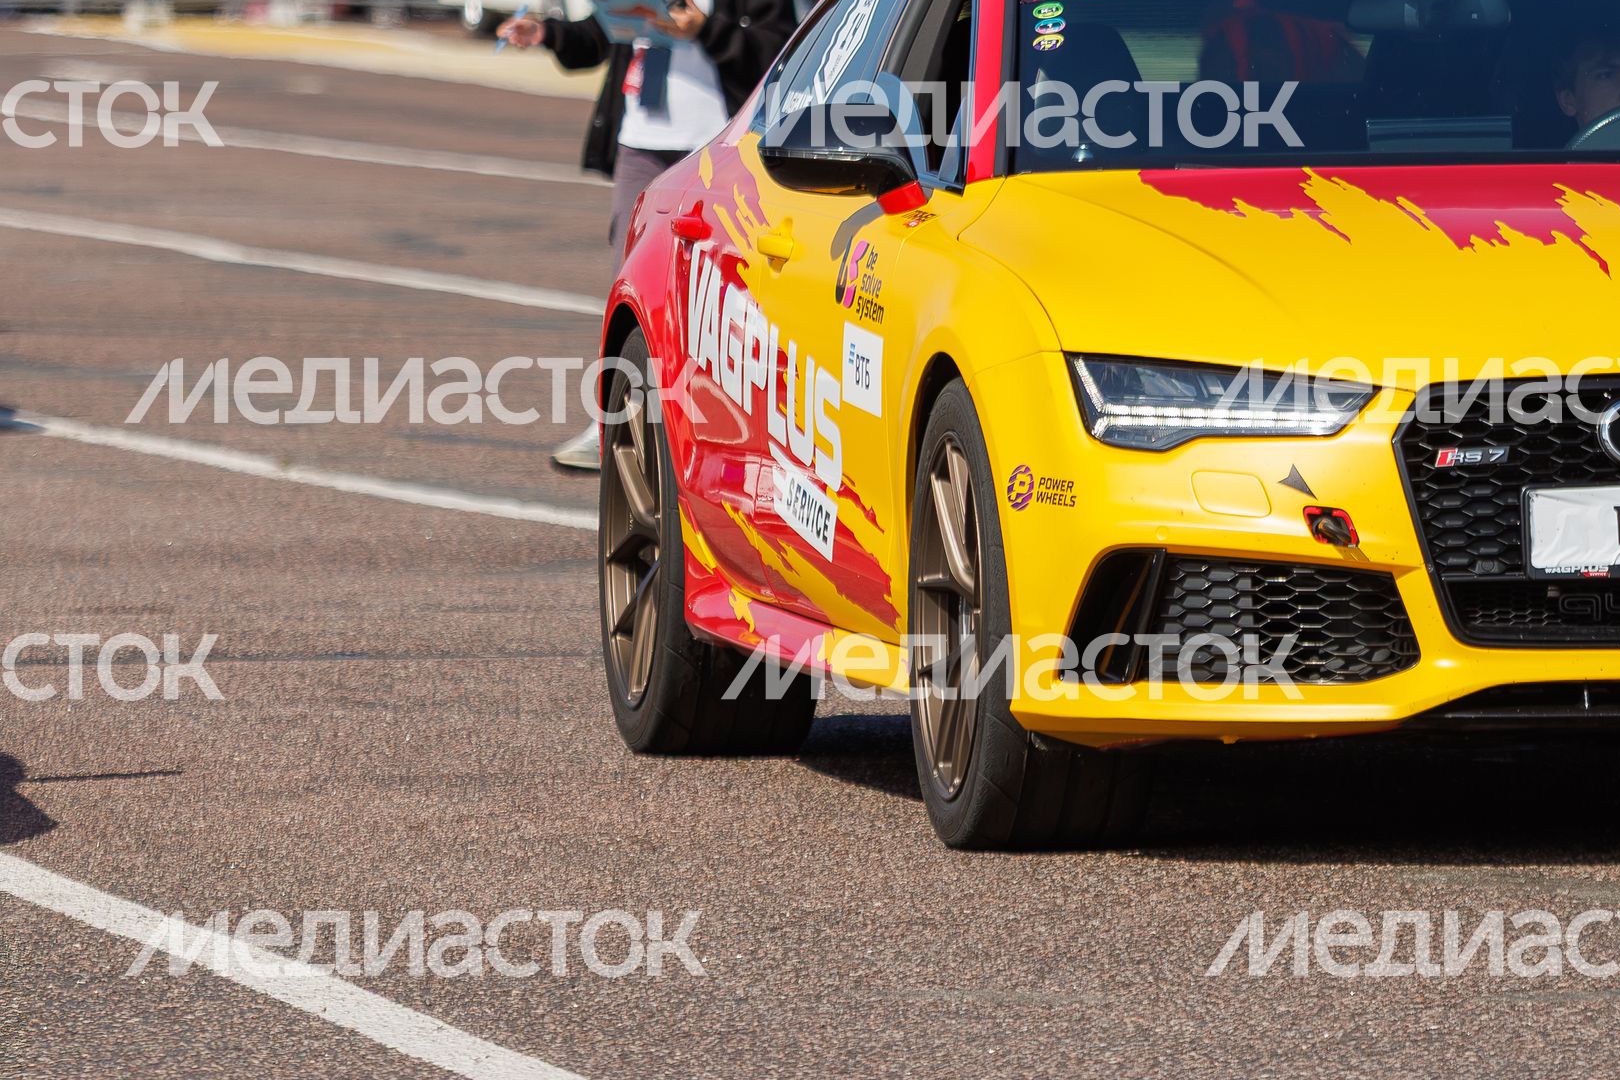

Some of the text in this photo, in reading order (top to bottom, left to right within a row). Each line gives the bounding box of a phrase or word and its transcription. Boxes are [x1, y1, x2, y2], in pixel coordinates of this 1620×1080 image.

[866, 245, 878, 271] be
[860, 271, 882, 299] solve
[856, 294, 884, 325] system
[688, 242, 843, 492] VAGPLUS
[855, 353, 871, 391] ВТБ
[1036, 490, 1077, 508] WHEELS
[1038, 476, 1075, 494] POWER
[786, 476, 831, 546] SERVICE
